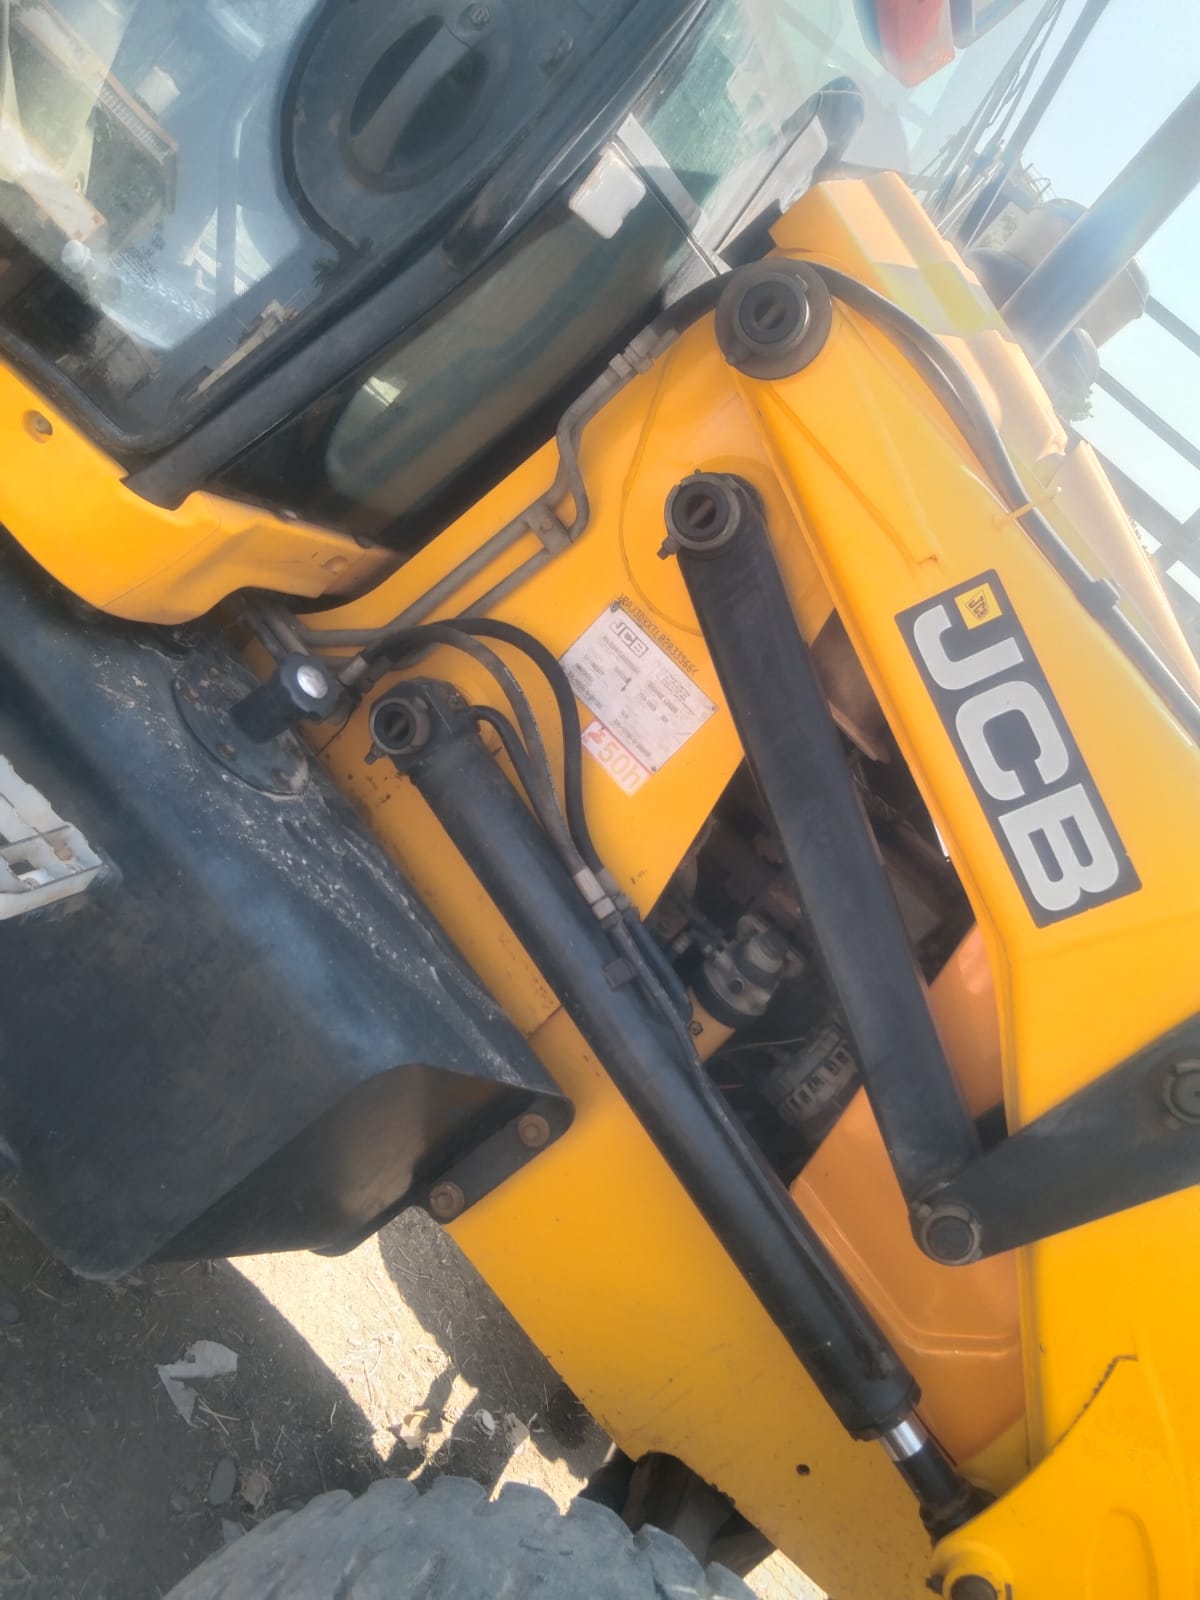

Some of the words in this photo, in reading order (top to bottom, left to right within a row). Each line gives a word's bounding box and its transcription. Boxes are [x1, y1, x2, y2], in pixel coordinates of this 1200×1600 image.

[968, 595, 988, 618] JCB
[609, 621, 649, 658] JCB
[598, 741, 641, 790] 50h
[913, 604, 1120, 912] JCB
